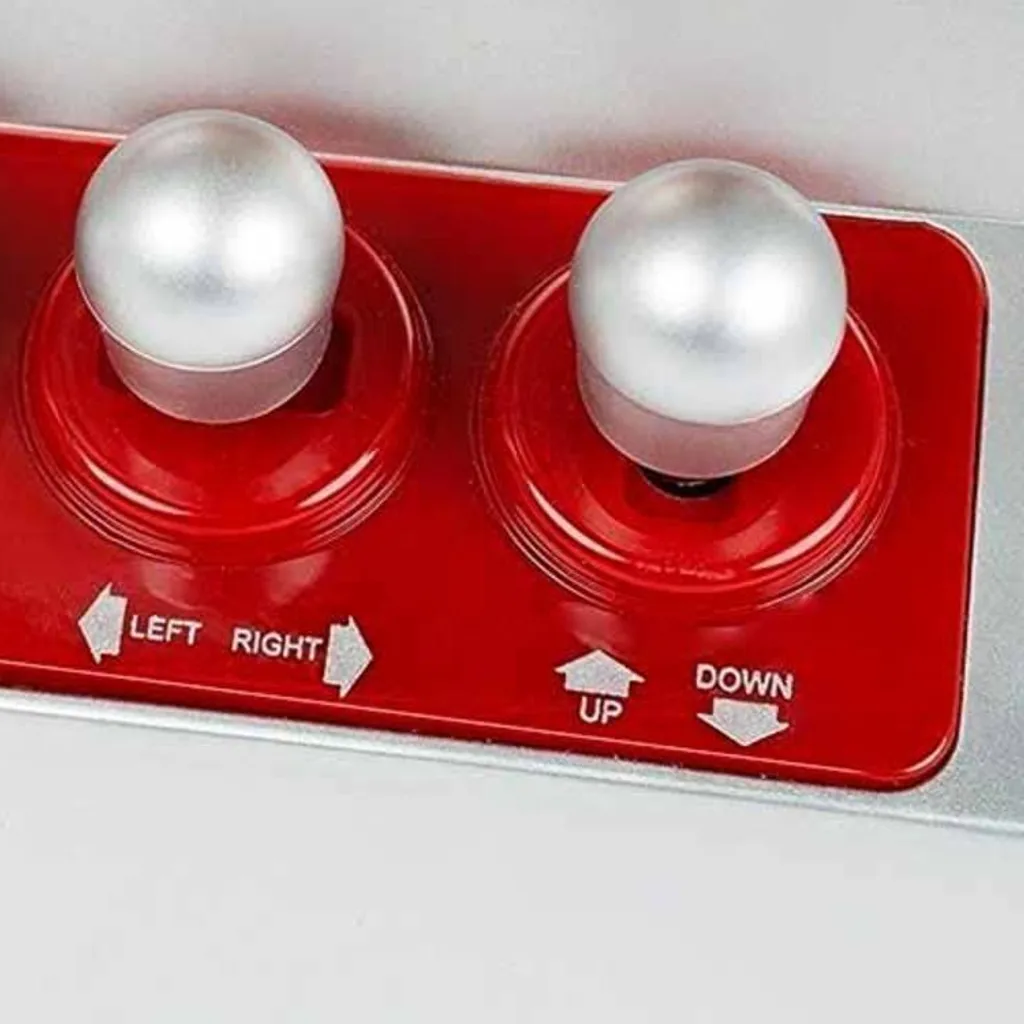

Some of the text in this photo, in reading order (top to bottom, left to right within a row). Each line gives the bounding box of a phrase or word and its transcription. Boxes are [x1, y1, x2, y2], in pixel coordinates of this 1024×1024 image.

[129, 613, 202, 646] LEFT
[231, 627, 323, 662] RIGHT
[696, 663, 794, 698] DOWN
[579, 695, 624, 724] UP
